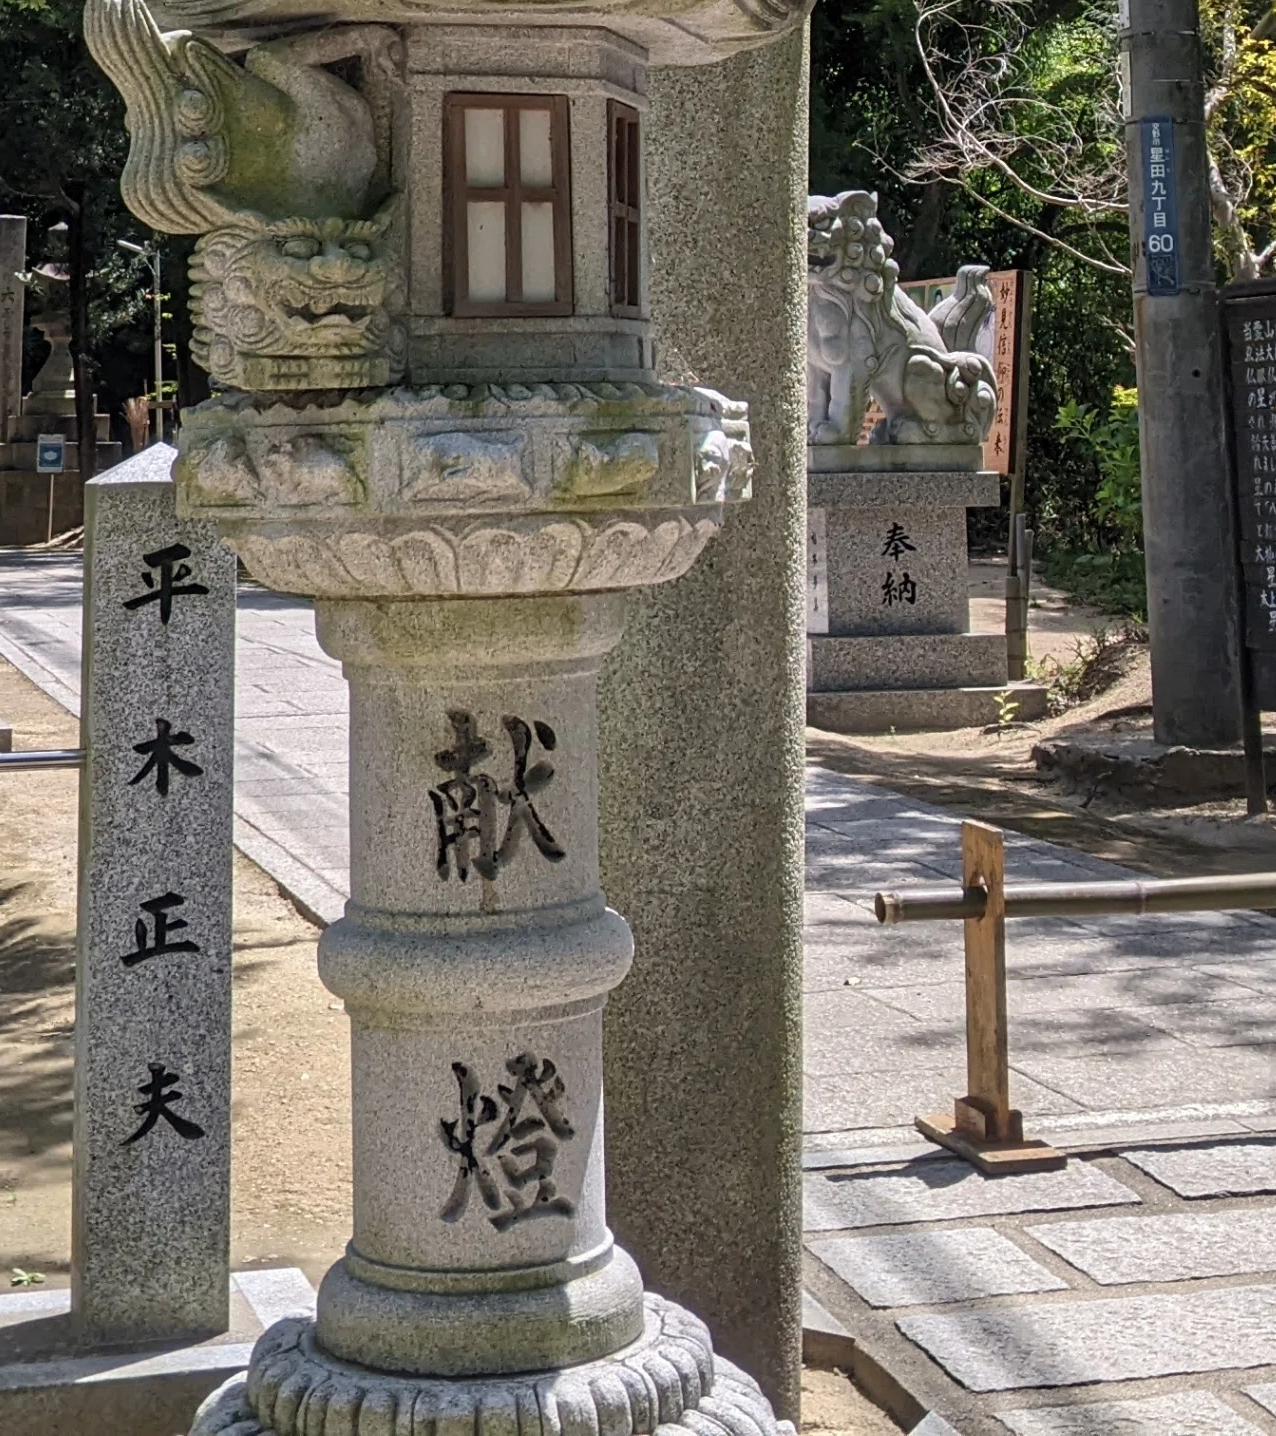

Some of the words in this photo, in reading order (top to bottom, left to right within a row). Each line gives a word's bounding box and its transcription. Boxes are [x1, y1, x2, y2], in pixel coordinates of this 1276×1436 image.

[1150, 147, 1166, 228] 星田九丁目
[1148, 234, 1173, 253] 60
[881, 522, 917, 607] 奉納
[121, 542, 210, 1146] 平木正夫
